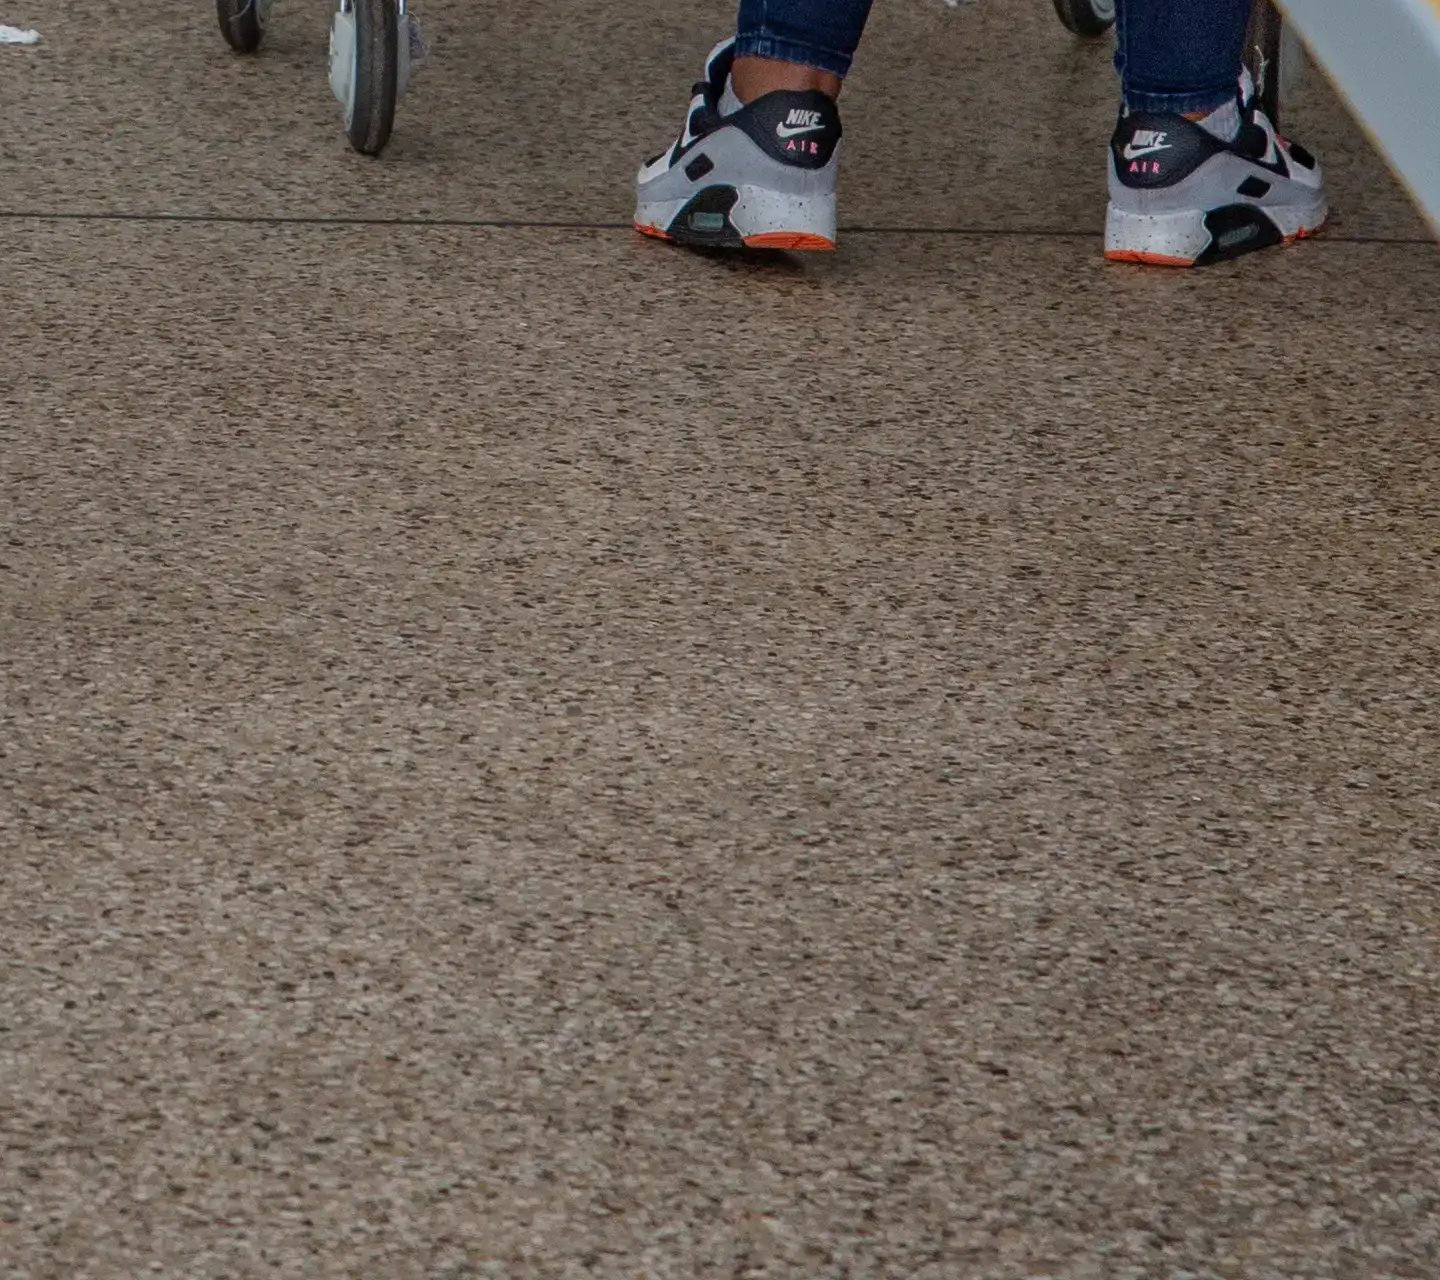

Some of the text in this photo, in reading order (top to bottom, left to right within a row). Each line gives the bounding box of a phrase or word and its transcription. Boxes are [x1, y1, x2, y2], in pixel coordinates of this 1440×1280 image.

[785, 109, 822, 127] NIKE
[786, 139, 818, 155] AIR
[1131, 130, 1168, 148] NIKE
[1129, 161, 1160, 175] AIR
